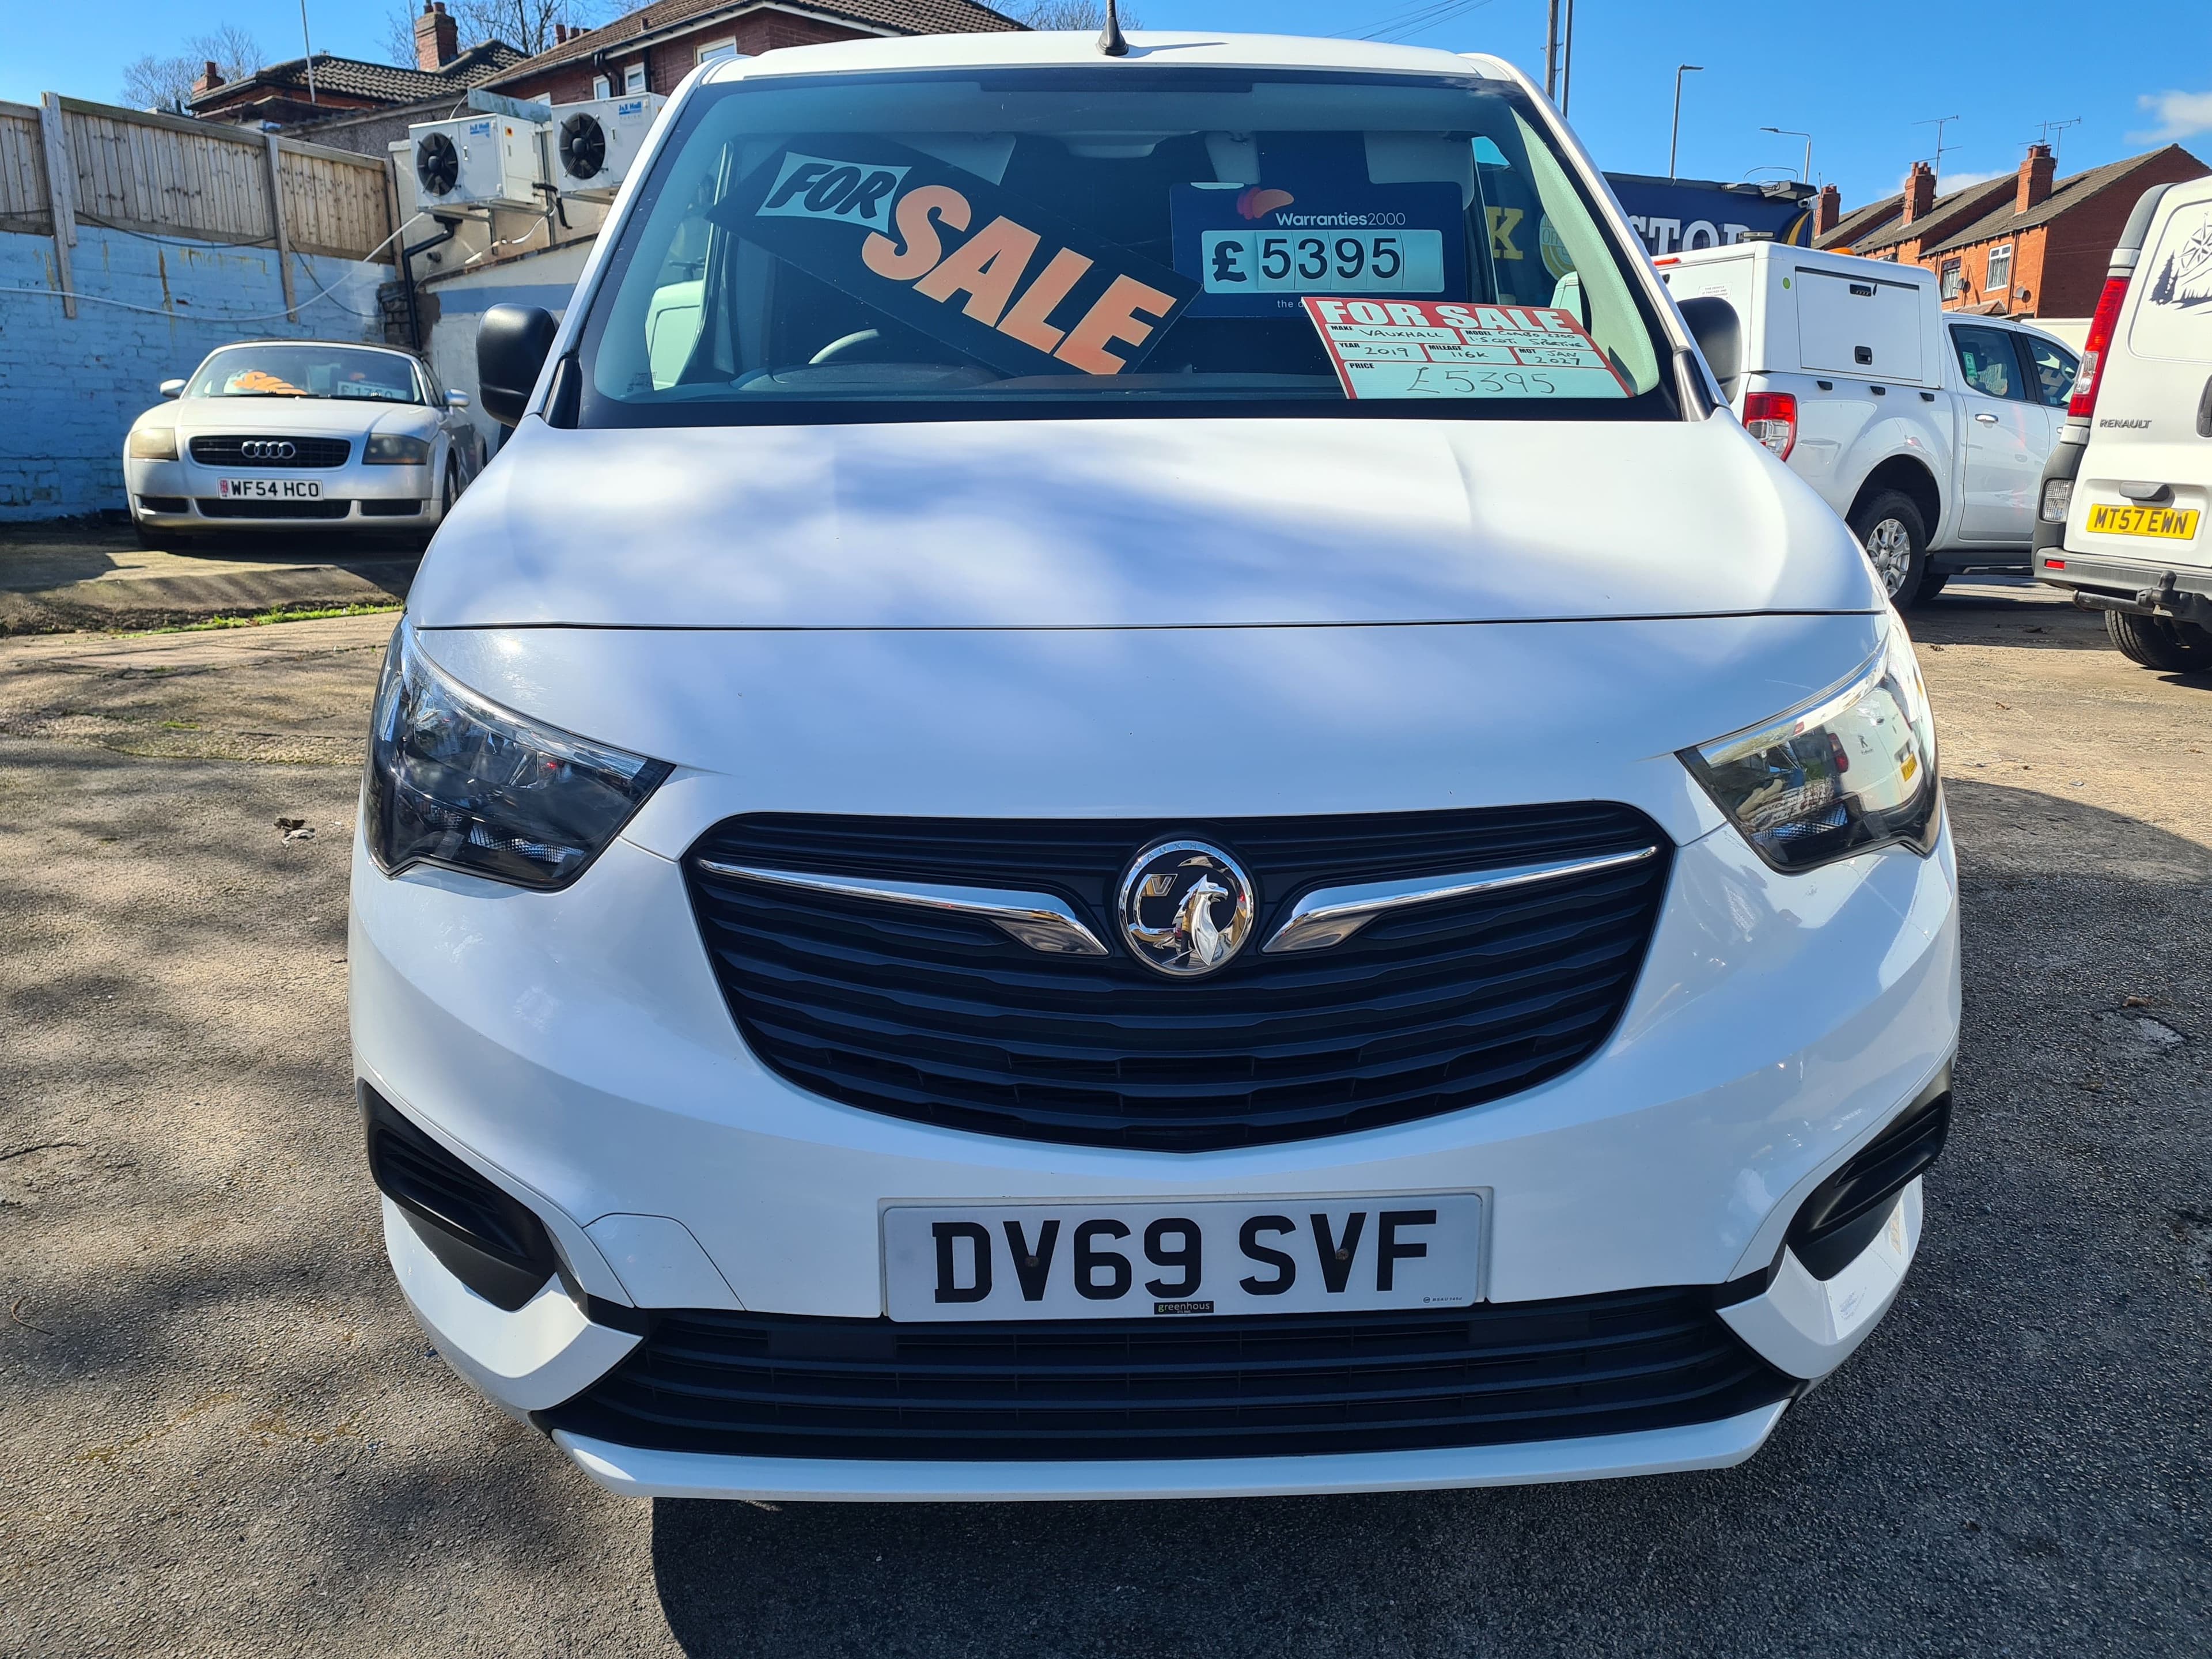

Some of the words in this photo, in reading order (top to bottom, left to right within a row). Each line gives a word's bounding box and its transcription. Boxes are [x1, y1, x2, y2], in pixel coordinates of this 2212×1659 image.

[765, 162, 896, 219] FOR
[1275, 211, 1406, 226] Warranties2000
[861, 184, 1177, 374] SALE
[1277, 300, 1294, 308] the
[1316, 300, 1431, 327] FOR
[1435, 305, 1575, 334] SALE
[1359, 329, 1444, 338] VAUXHALL
[1364, 347, 1410, 358] 2019
[1534, 356, 1581, 366] 2027
[1406, 366, 1555, 394] £5395
[2100, 419, 2152, 429] RENAULT
[231, 480, 278, 497] WF54
[283, 482, 319, 497] HCO
[2094, 507, 2145, 531] MT57
[2147, 509, 2189, 535] EWN
[1135, 842, 1234, 870] VAUXHALL
[931, 1217, 1202, 1304] DV69
[1238, 1209, 1437, 1296] SVF
[1158, 1302, 1210, 1313] greenhous
